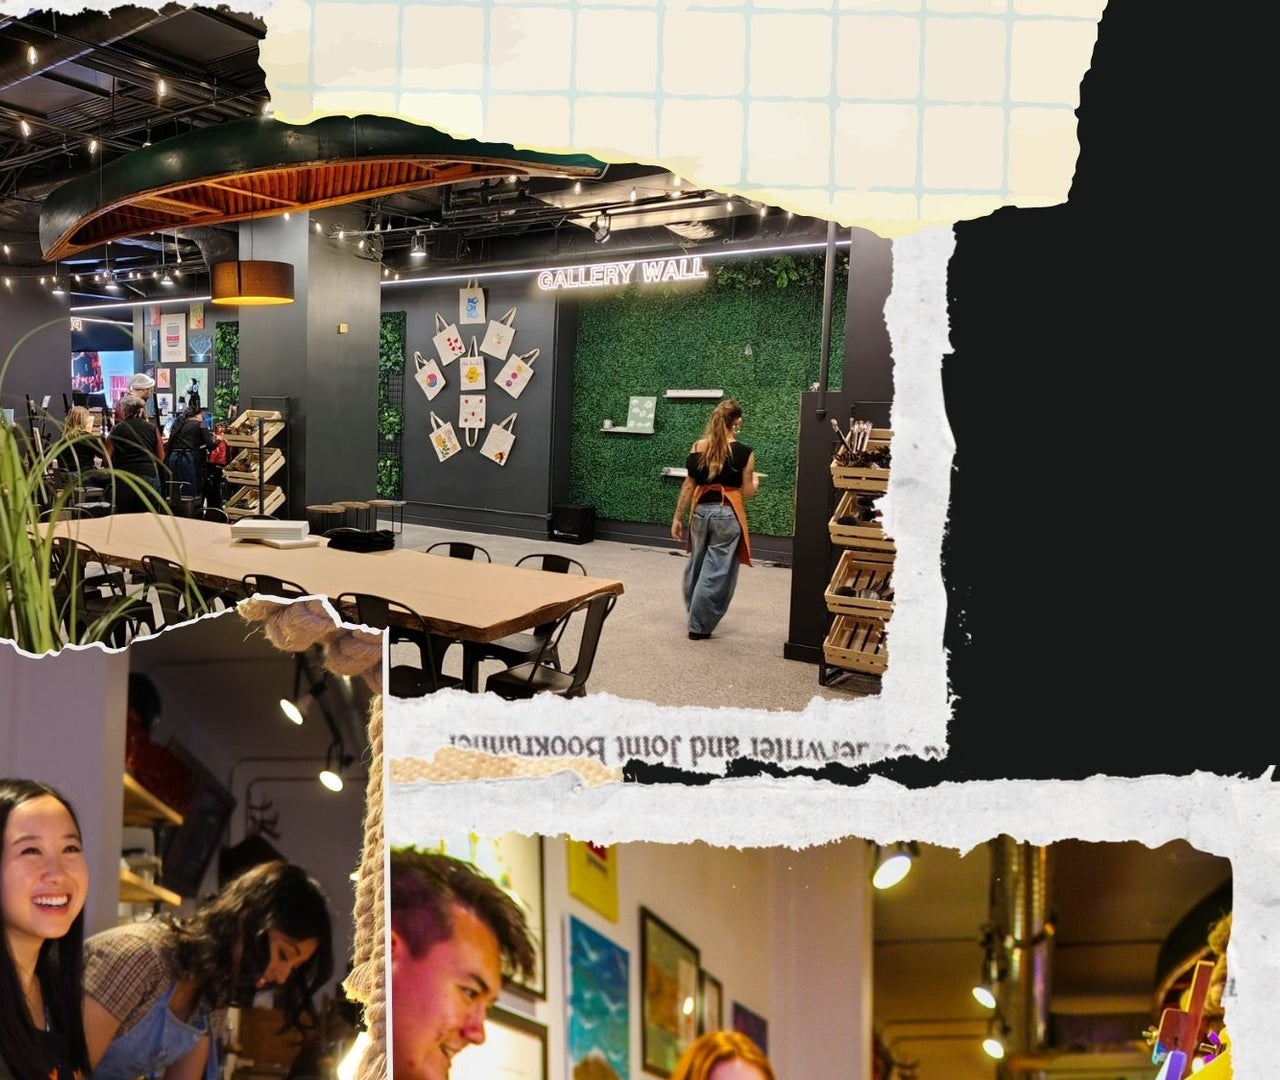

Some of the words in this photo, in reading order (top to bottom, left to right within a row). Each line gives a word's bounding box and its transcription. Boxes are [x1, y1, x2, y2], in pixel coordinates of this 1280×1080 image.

[538, 264, 635, 290] GALLERY
[642, 257, 708, 283] WALL
[690, 736, 739, 766] and
